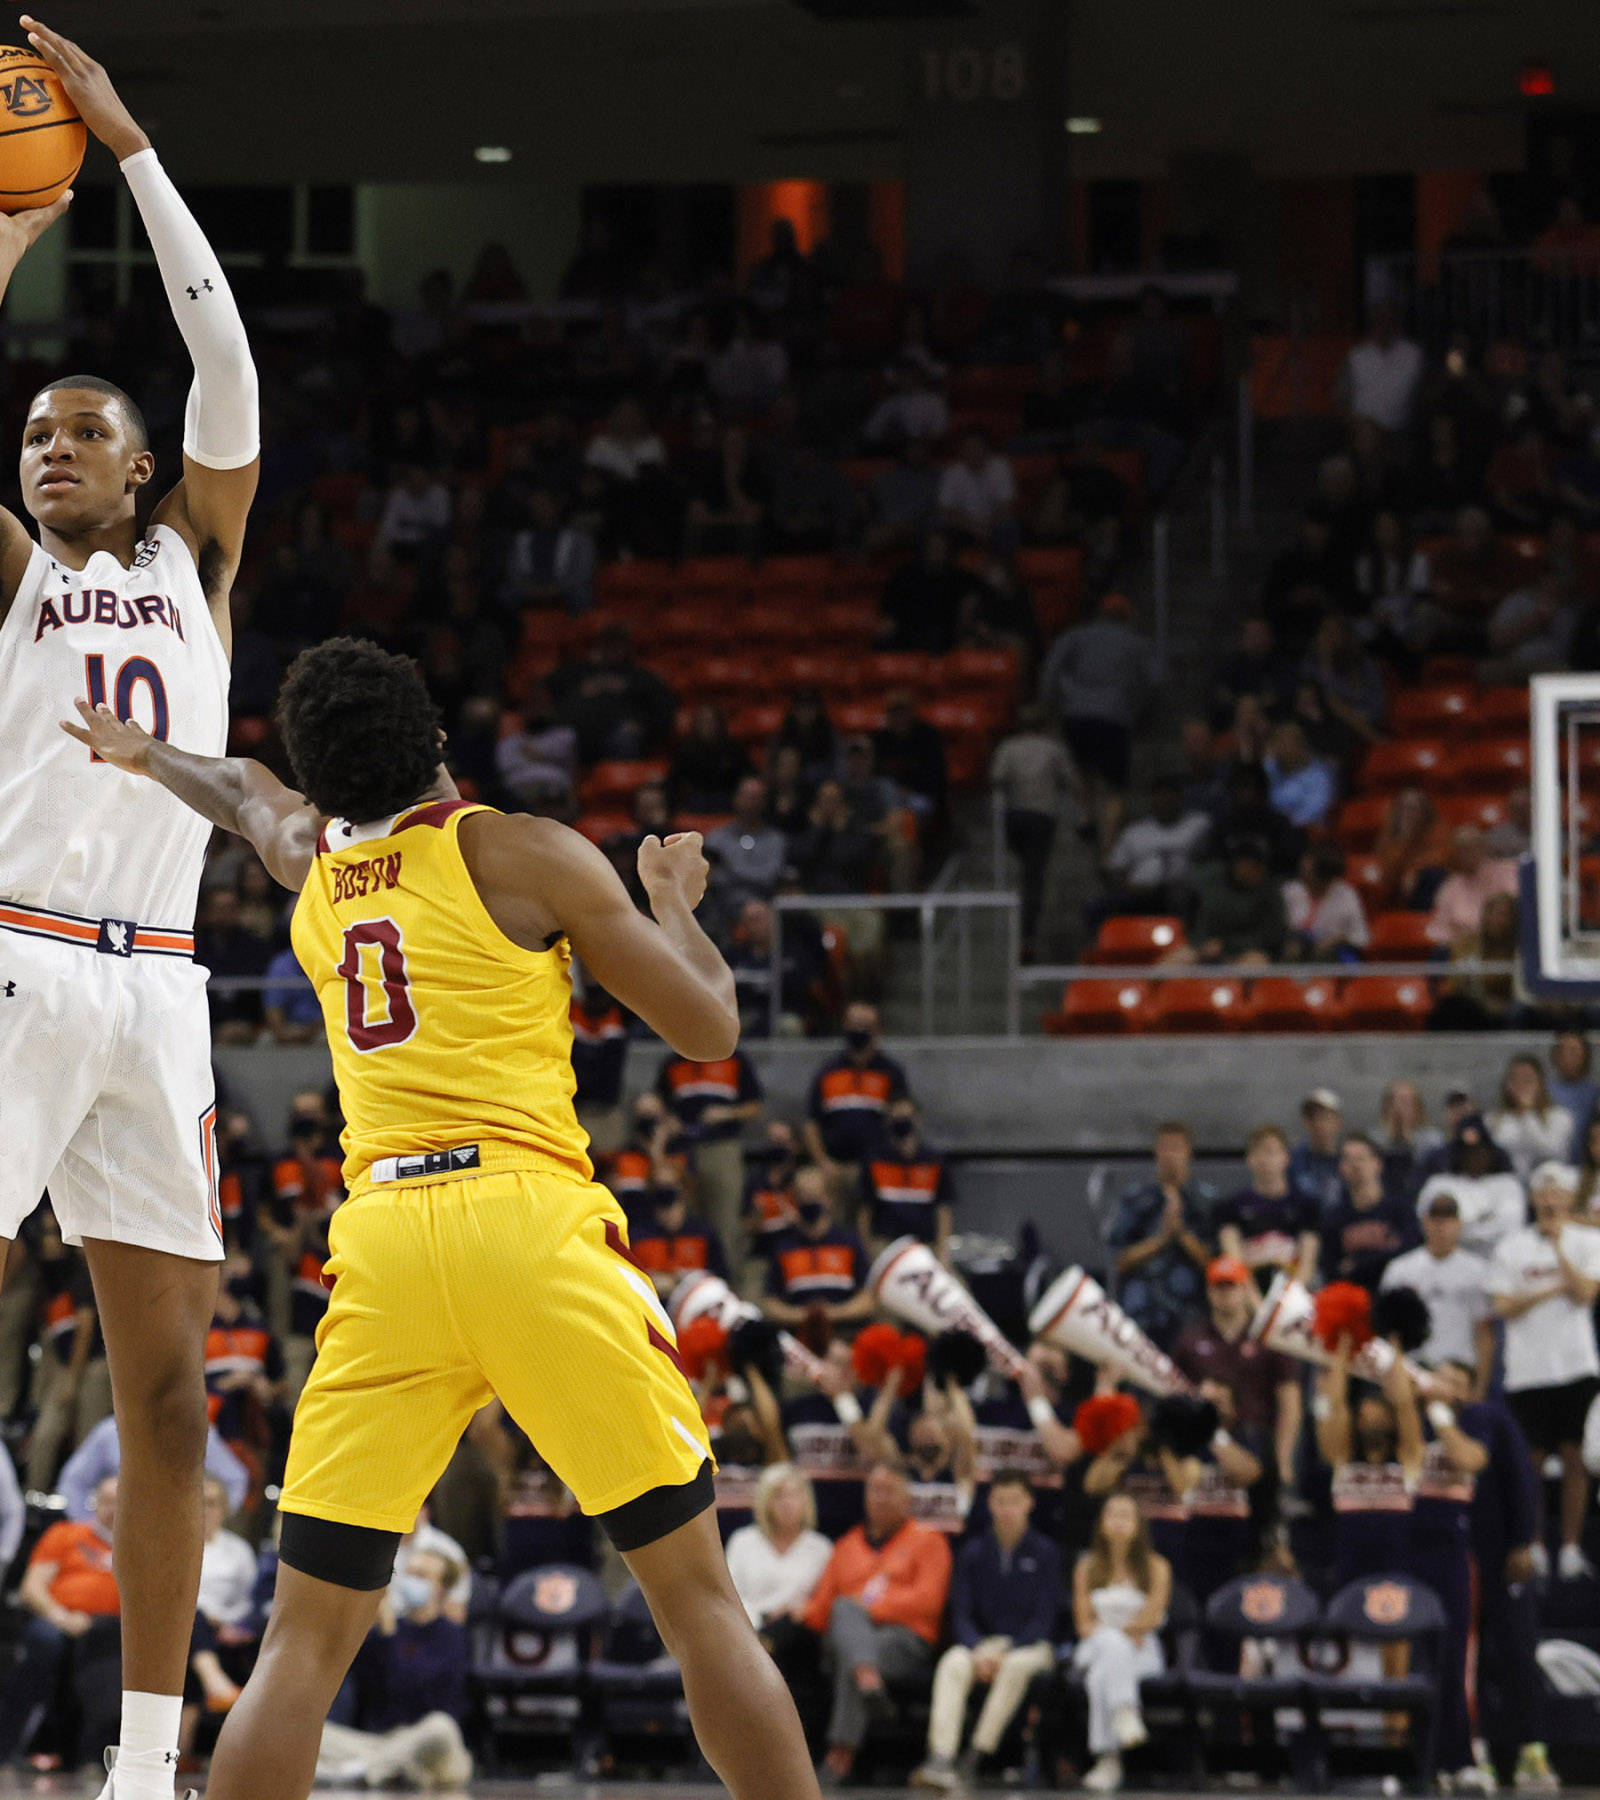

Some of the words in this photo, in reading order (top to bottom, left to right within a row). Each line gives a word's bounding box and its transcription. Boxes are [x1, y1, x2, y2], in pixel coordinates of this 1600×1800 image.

[919, 47, 1025, 101] 108
[34, 589, 186, 643] AUBURN
[85, 654, 169, 762] 10
[337, 915, 419, 1055] 0
